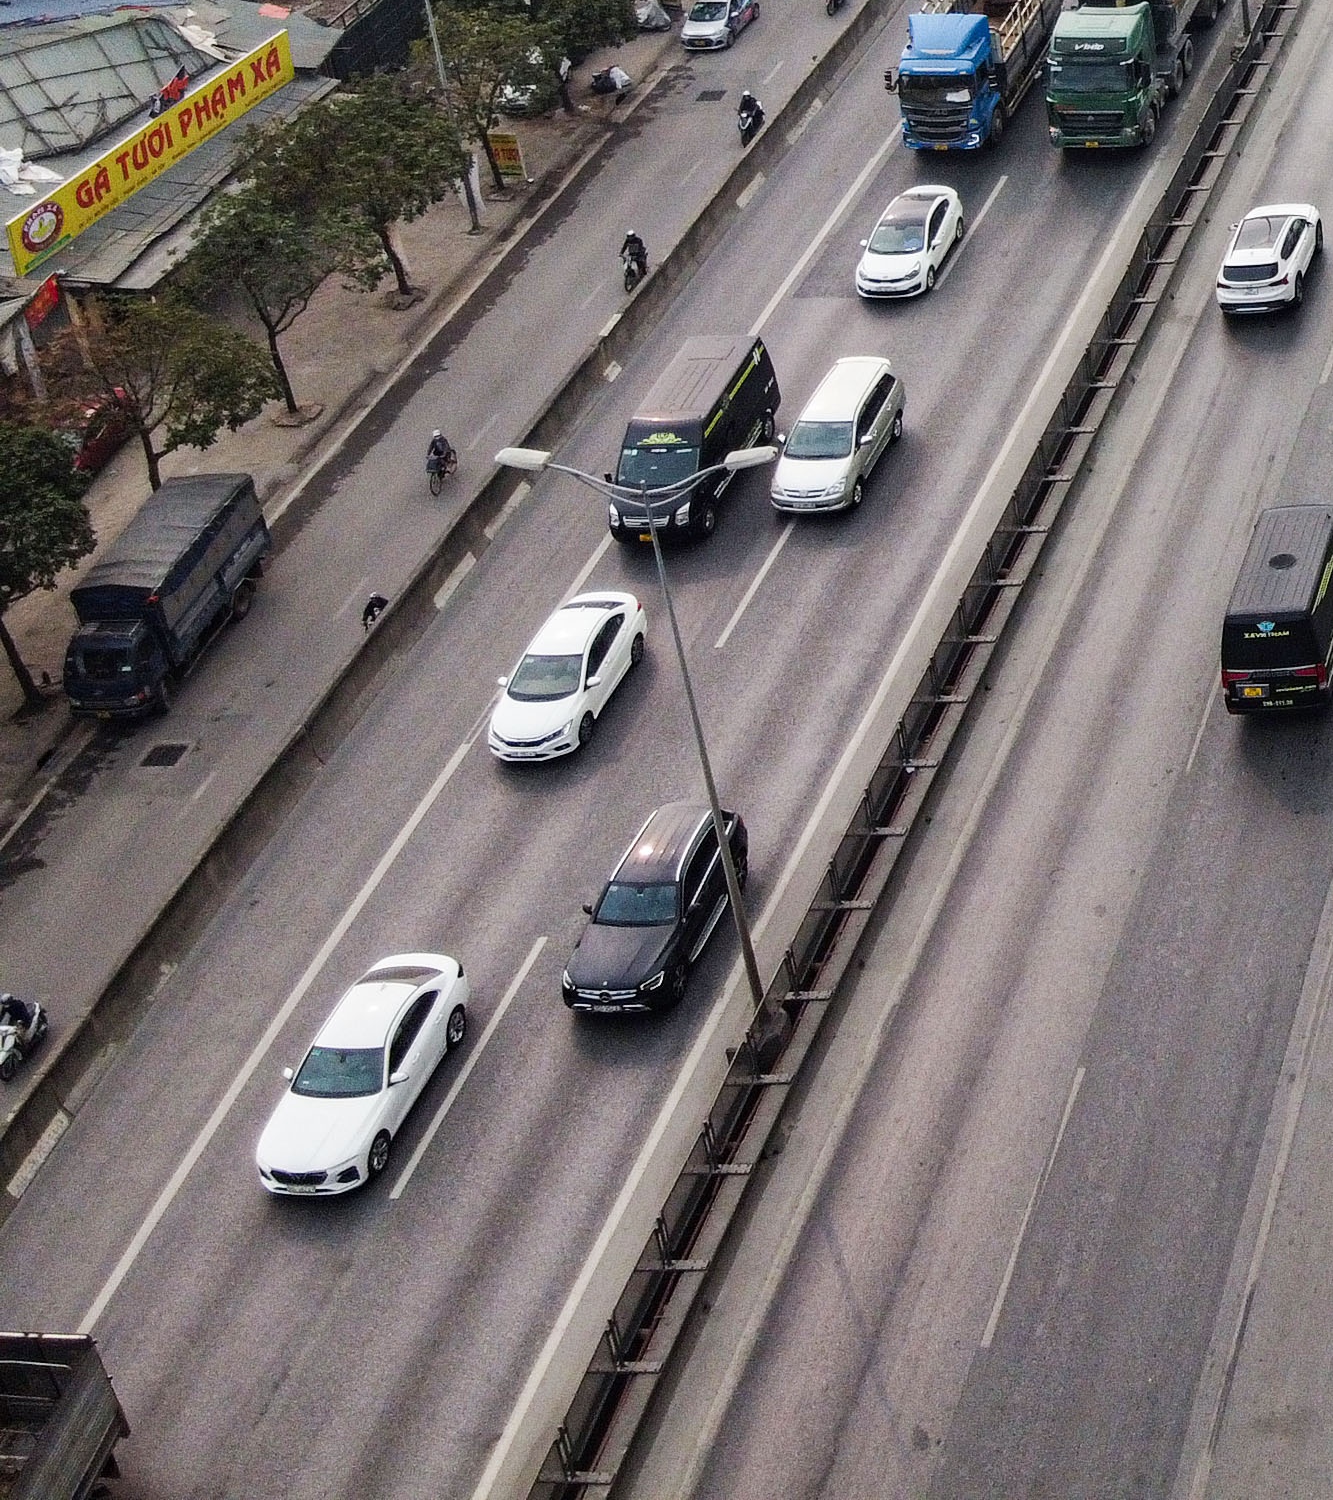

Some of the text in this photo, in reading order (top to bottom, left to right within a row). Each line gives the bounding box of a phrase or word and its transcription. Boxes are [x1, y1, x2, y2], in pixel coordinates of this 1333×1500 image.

[75, 164, 112, 209] GÀ
[115, 121, 173, 181] TƯƠI
[178, 70, 253, 138] PHẠM
[249, 43, 282, 89] XÁ
